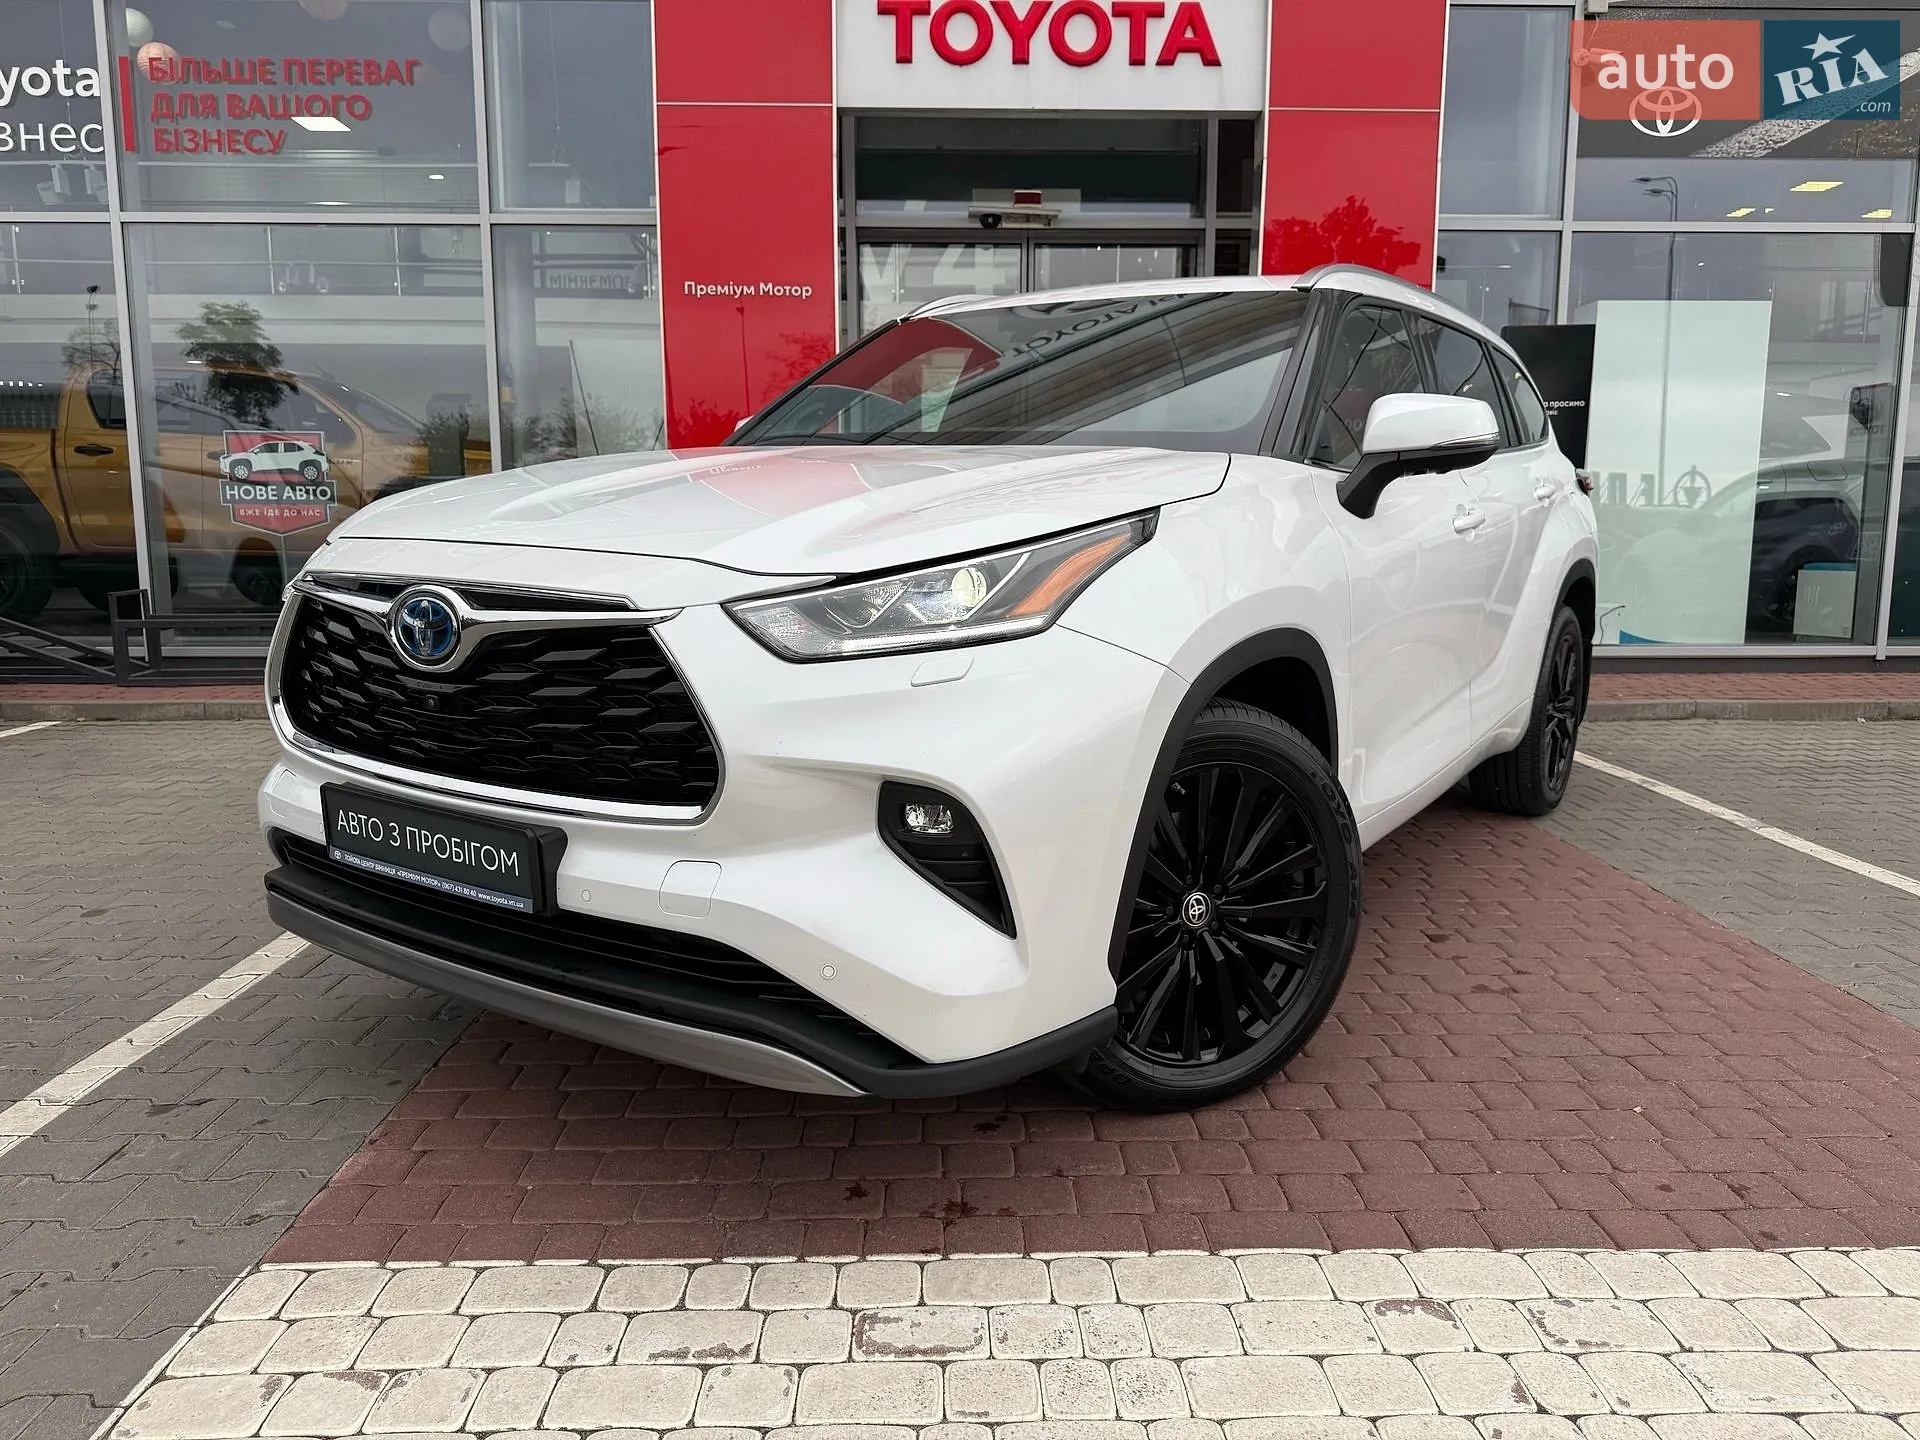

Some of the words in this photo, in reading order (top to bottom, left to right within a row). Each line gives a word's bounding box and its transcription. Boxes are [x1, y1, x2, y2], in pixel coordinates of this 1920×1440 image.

[877, 0, 1222, 67] TOYOTA
[148, 56, 273, 84] БІЛЬШЕ
[283, 57, 422, 84] ПЕРЕВАГ
[151, 93, 217, 122] ДЛЯ
[226, 94, 371, 120] ВАШОГО
[154, 128, 285, 155] БІЗНЕСУ
[684, 281, 755, 298] Преміум
[759, 282, 812, 299] Мотор
[1550, 400, 1585, 409] просимо
[226, 485, 277, 500] НОВЕ
[283, 485, 331, 500] АВТО
[263, 507, 280, 517] ЇДЕ
[283, 509, 297, 517] ДО
[301, 509, 321, 517] НАС
[338, 809, 383, 842] АВТО
[406, 826, 519, 877] ПРОБІГОМ
